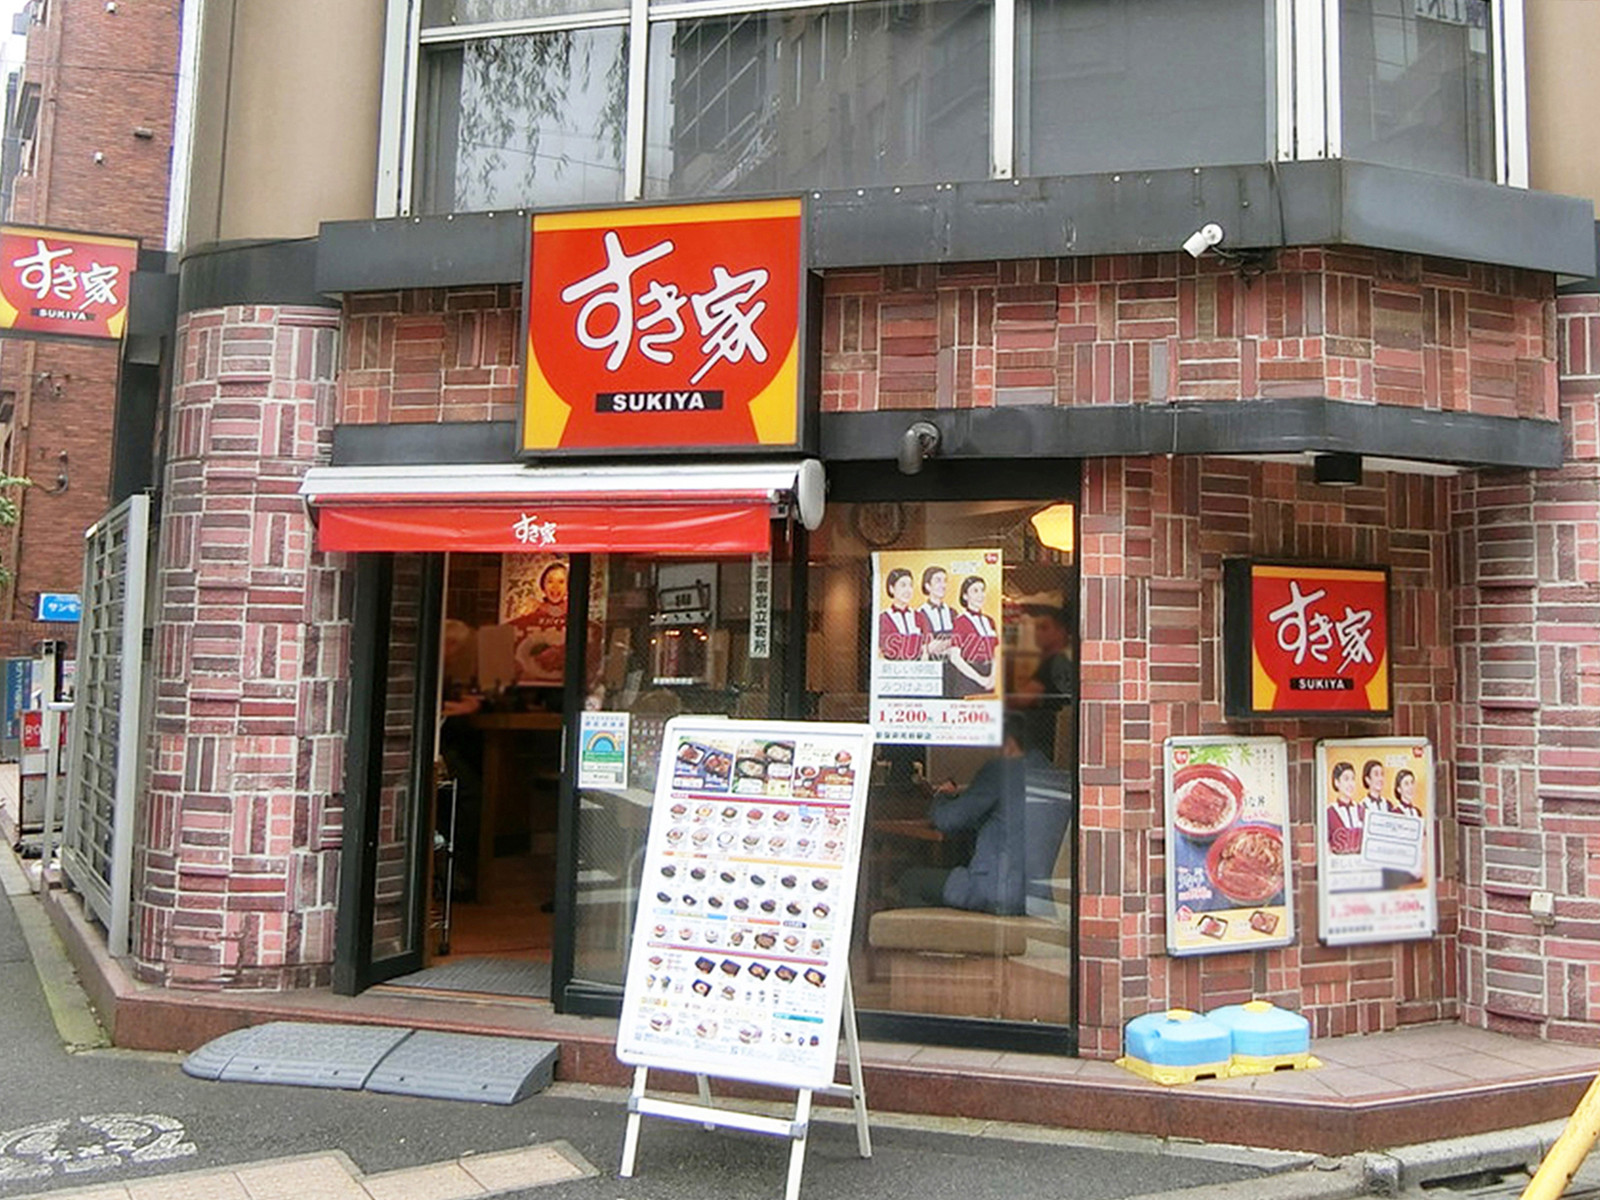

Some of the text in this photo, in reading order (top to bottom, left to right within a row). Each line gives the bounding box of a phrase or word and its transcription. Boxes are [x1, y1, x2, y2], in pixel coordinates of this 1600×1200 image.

[12, 239, 120, 310] すき家
[39, 308, 88, 321] SUKIYA
[560, 229, 770, 386] すき家
[612, 391, 706, 412] SUKIYA
[512, 512, 557, 547] すき家
[1268, 580, 1374, 674] すき家
[1298, 678, 1346, 690] SUKIYA
